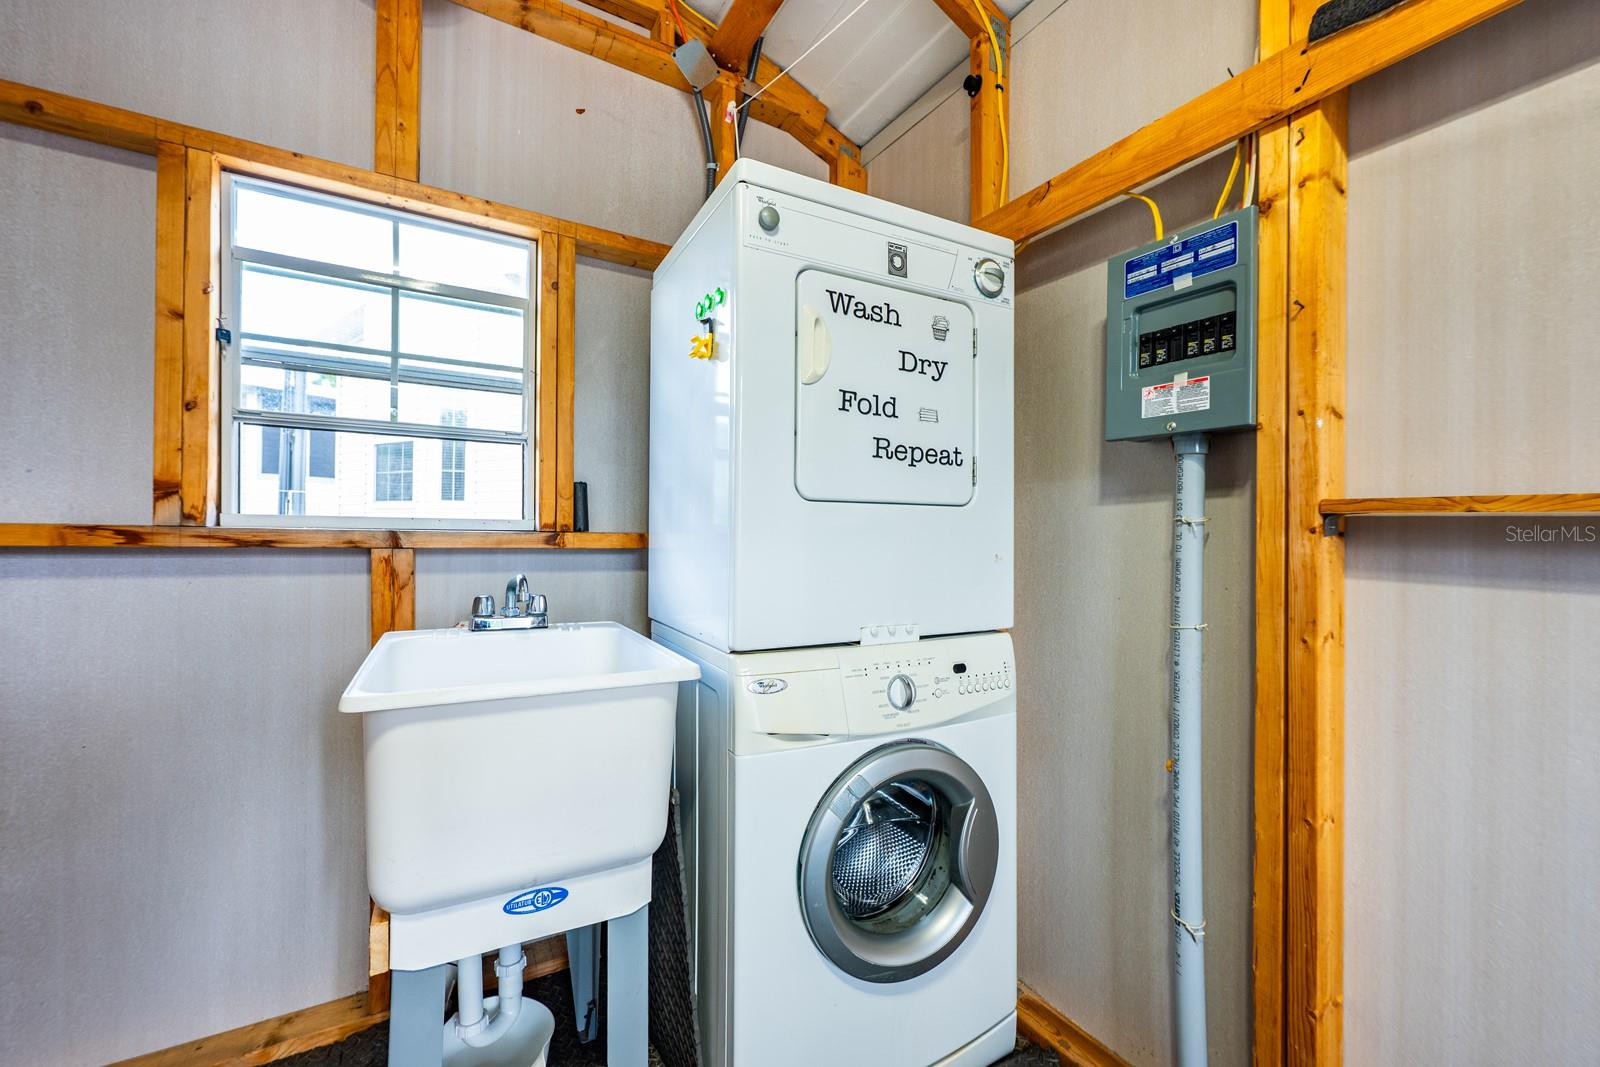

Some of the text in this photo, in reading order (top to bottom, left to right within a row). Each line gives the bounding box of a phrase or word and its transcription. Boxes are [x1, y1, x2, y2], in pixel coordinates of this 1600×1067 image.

[825, 289, 902, 327] Wash
[898, 350, 949, 382] Dry
[838, 389, 899, 419] Fold
[872, 436, 964, 468] Repeat
[1175, 514, 1183, 528] SD
[1175, 532, 1183, 541] UL
[1175, 544, 1183, 553] TO
[1174, 557, 1182, 593] CONFORMS
[1173, 630, 1181, 657] LISTED
[1173, 670, 1181, 704] INTERTEK
[1173, 851, 1181, 887] SCHEDULE
